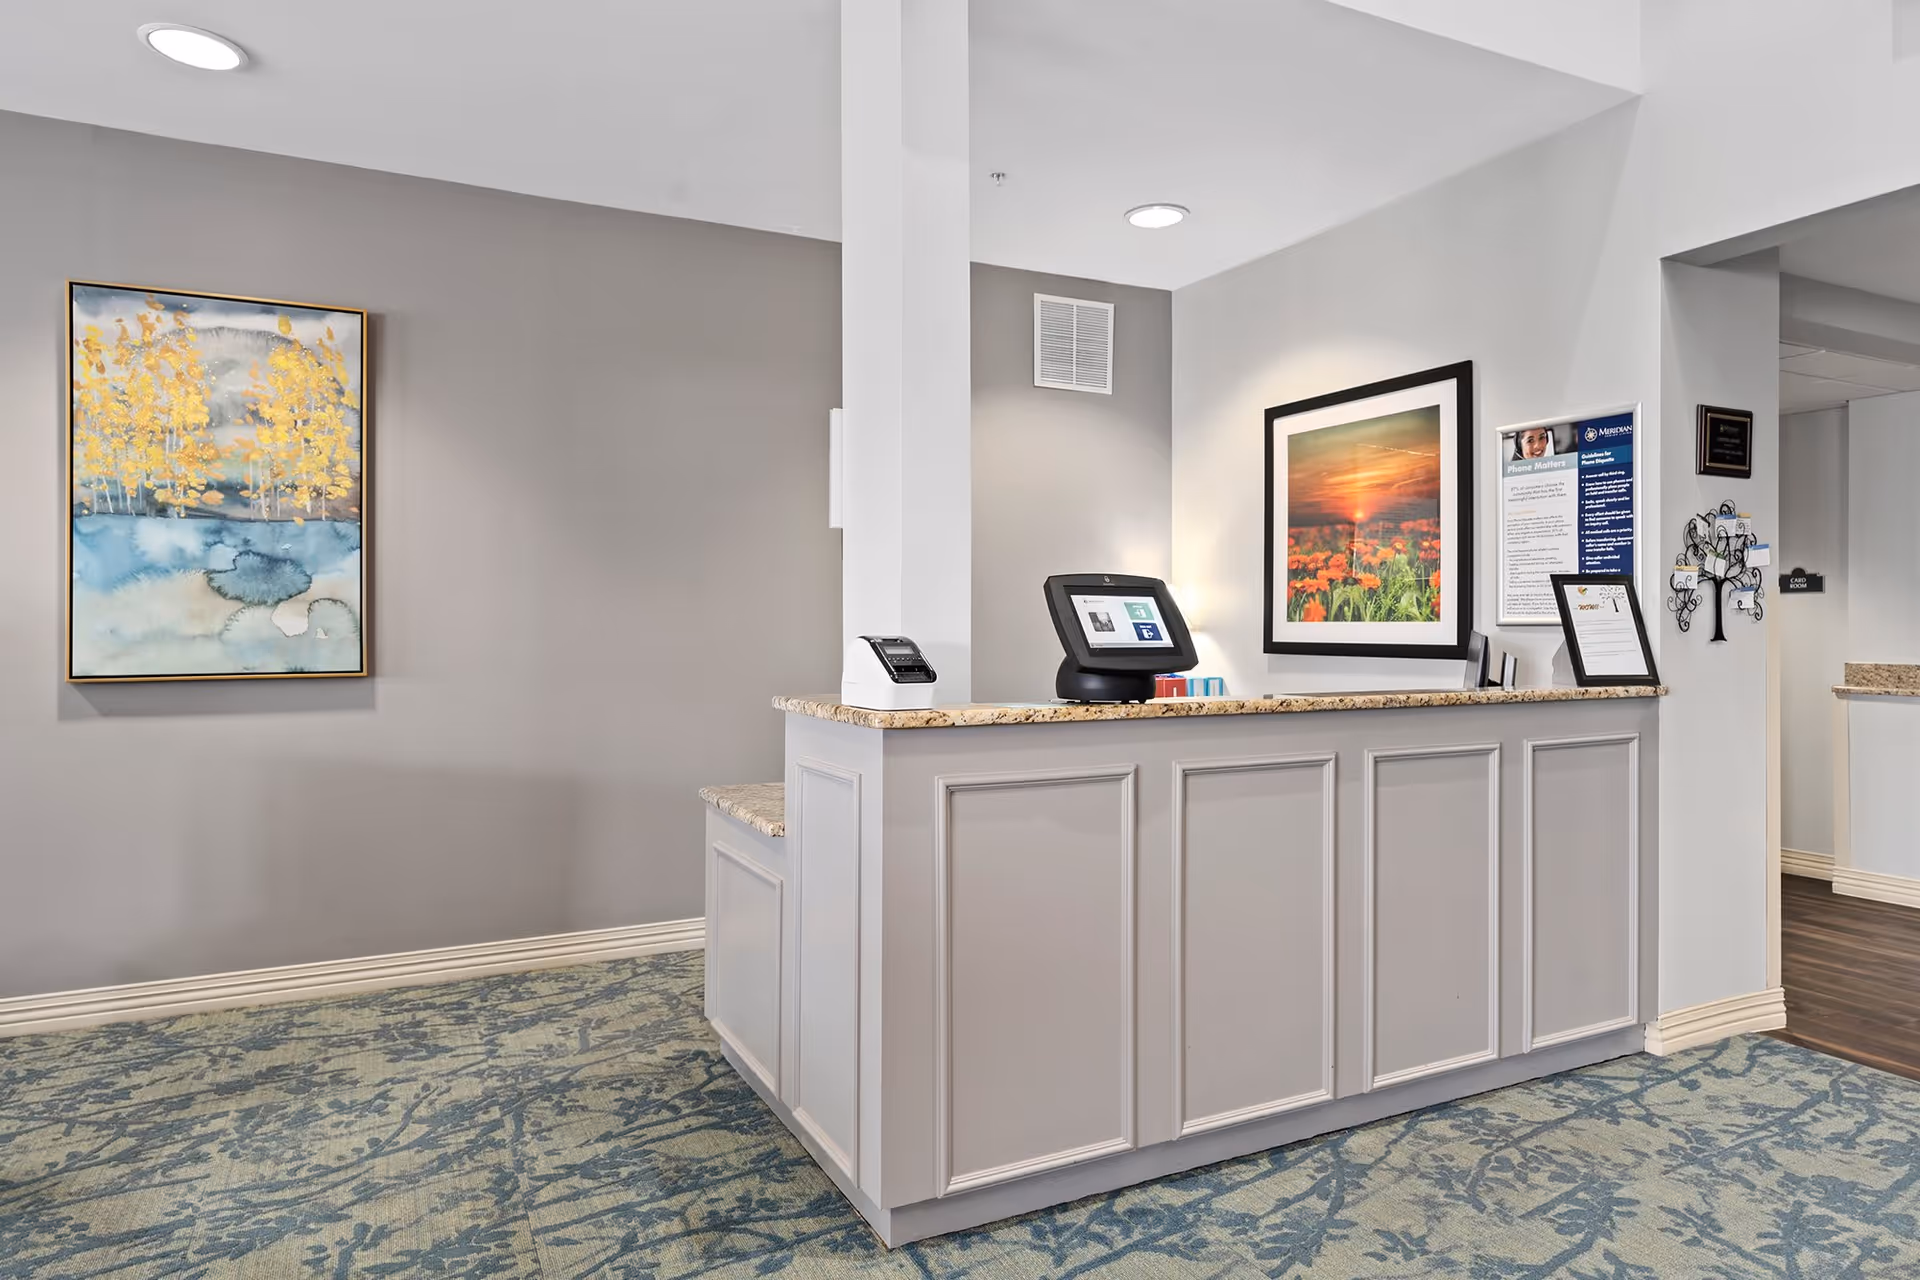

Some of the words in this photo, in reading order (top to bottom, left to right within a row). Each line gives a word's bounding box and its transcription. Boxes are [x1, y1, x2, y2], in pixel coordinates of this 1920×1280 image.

[1599, 425, 1632, 436] MERIDIAN
[1508, 465, 1532, 473] Phone
[1534, 460, 1566, 470] Matters
